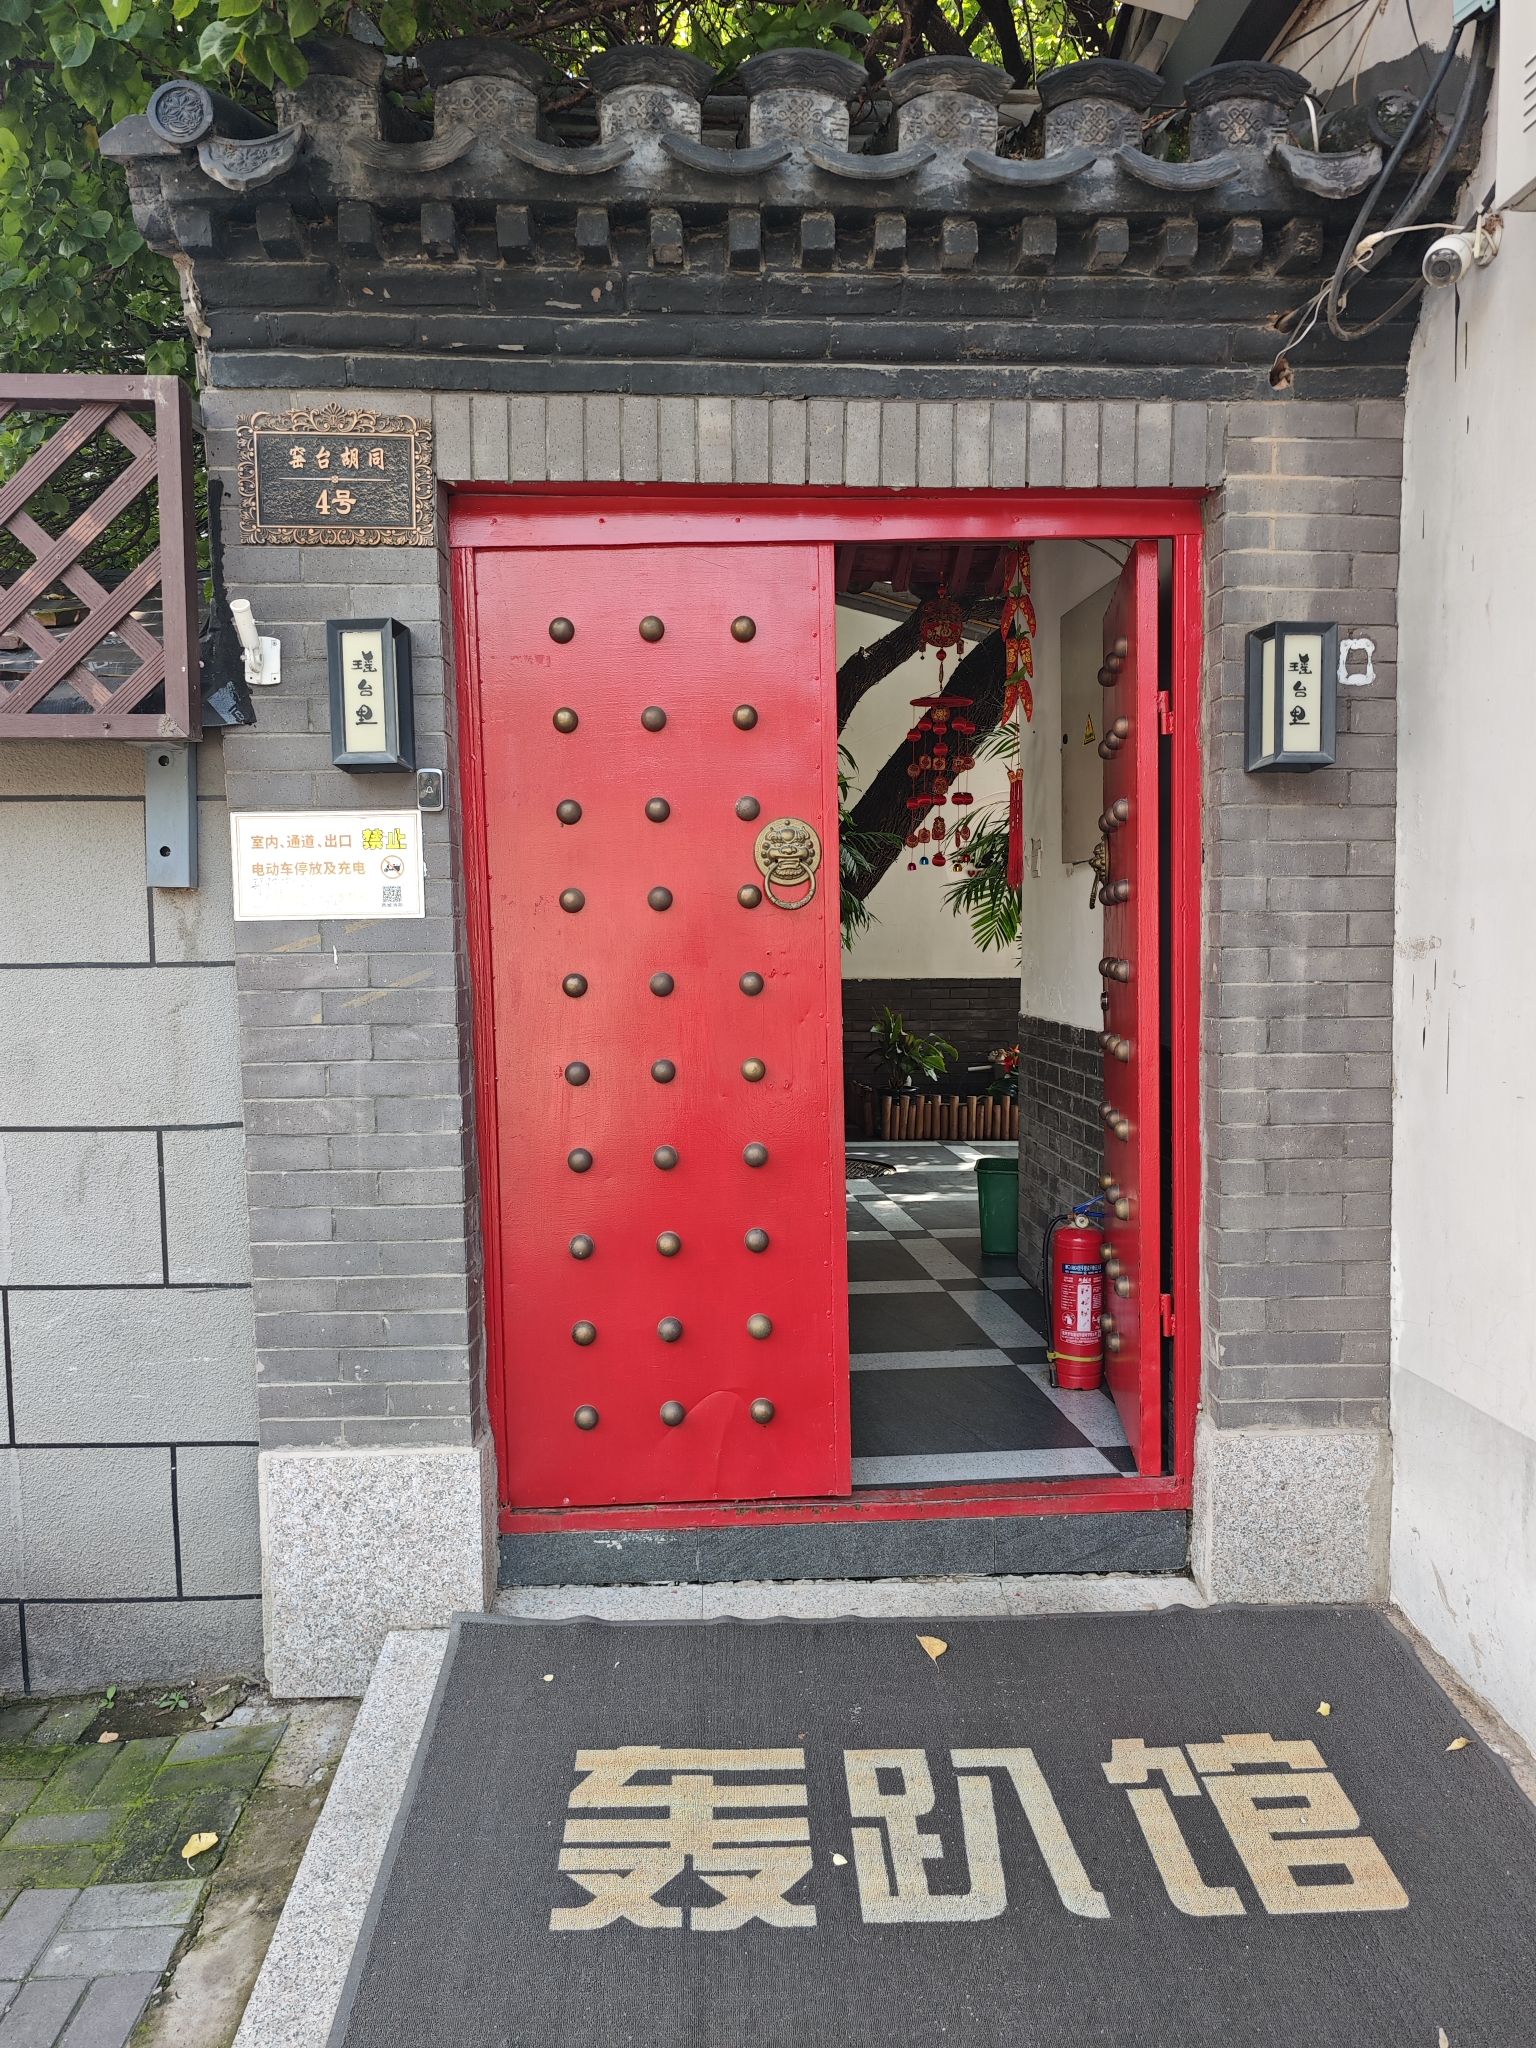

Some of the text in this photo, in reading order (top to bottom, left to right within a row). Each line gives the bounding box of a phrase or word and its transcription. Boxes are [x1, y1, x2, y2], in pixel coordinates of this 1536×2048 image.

[288, 446, 386, 471] 窑台胡同
[315, 489, 357, 516] 4号
[351, 650, 378, 726] 瑶台里
[1287, 653, 1313, 726] 瑶台里
[251, 828, 408, 851] 室内、通道、出口 禁止
[252, 861, 367, 877] 电动车停放及充电
[549, 1732, 1410, 1932] 轰趴馆
